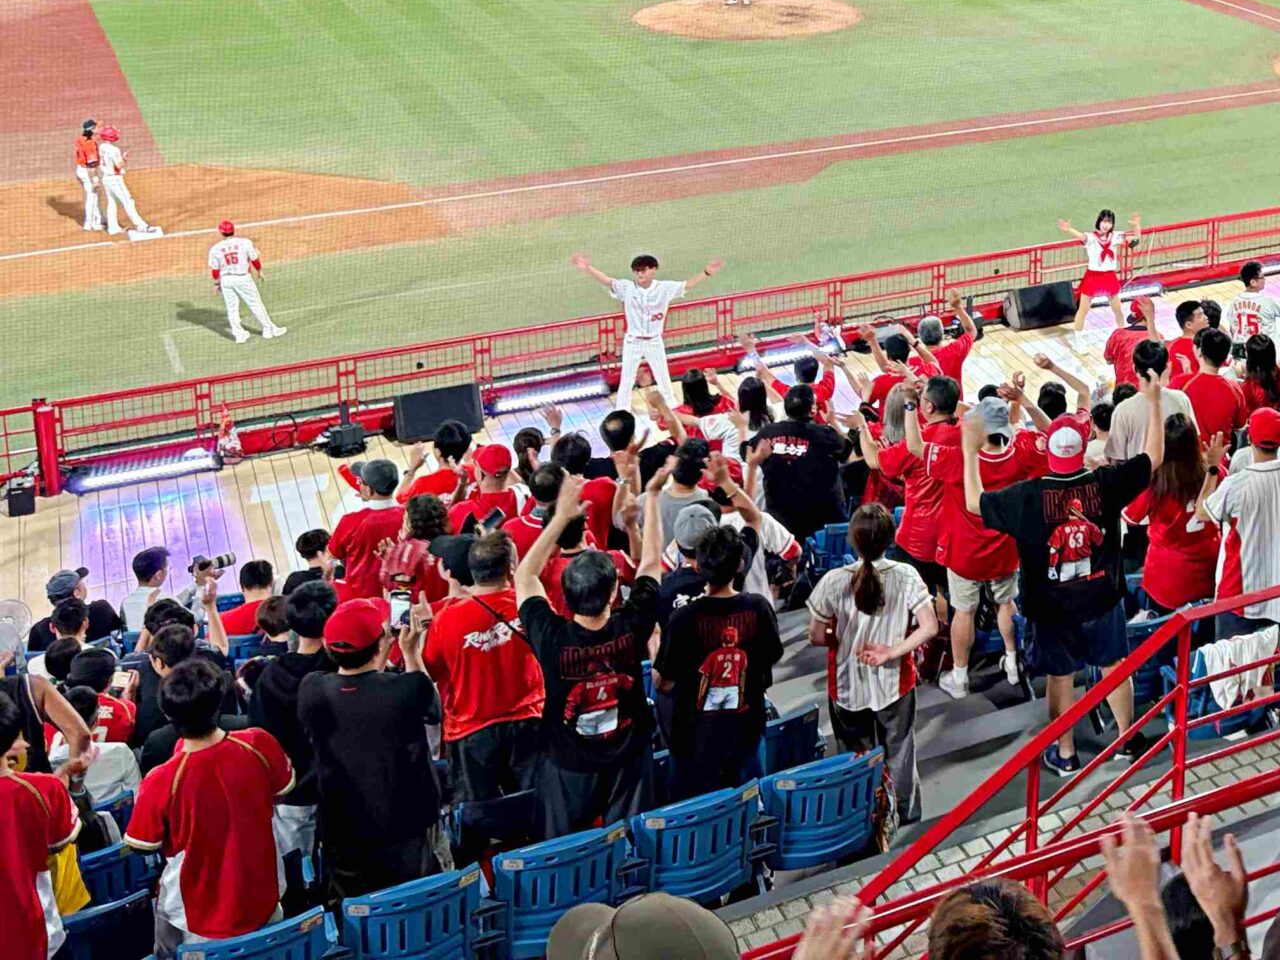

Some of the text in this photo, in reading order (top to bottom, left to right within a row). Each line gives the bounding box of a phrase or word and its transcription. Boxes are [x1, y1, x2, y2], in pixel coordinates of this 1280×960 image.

[1236, 313, 1259, 335] 15
[1068, 533, 1084, 548] 63
[722, 661, 733, 678] 2
